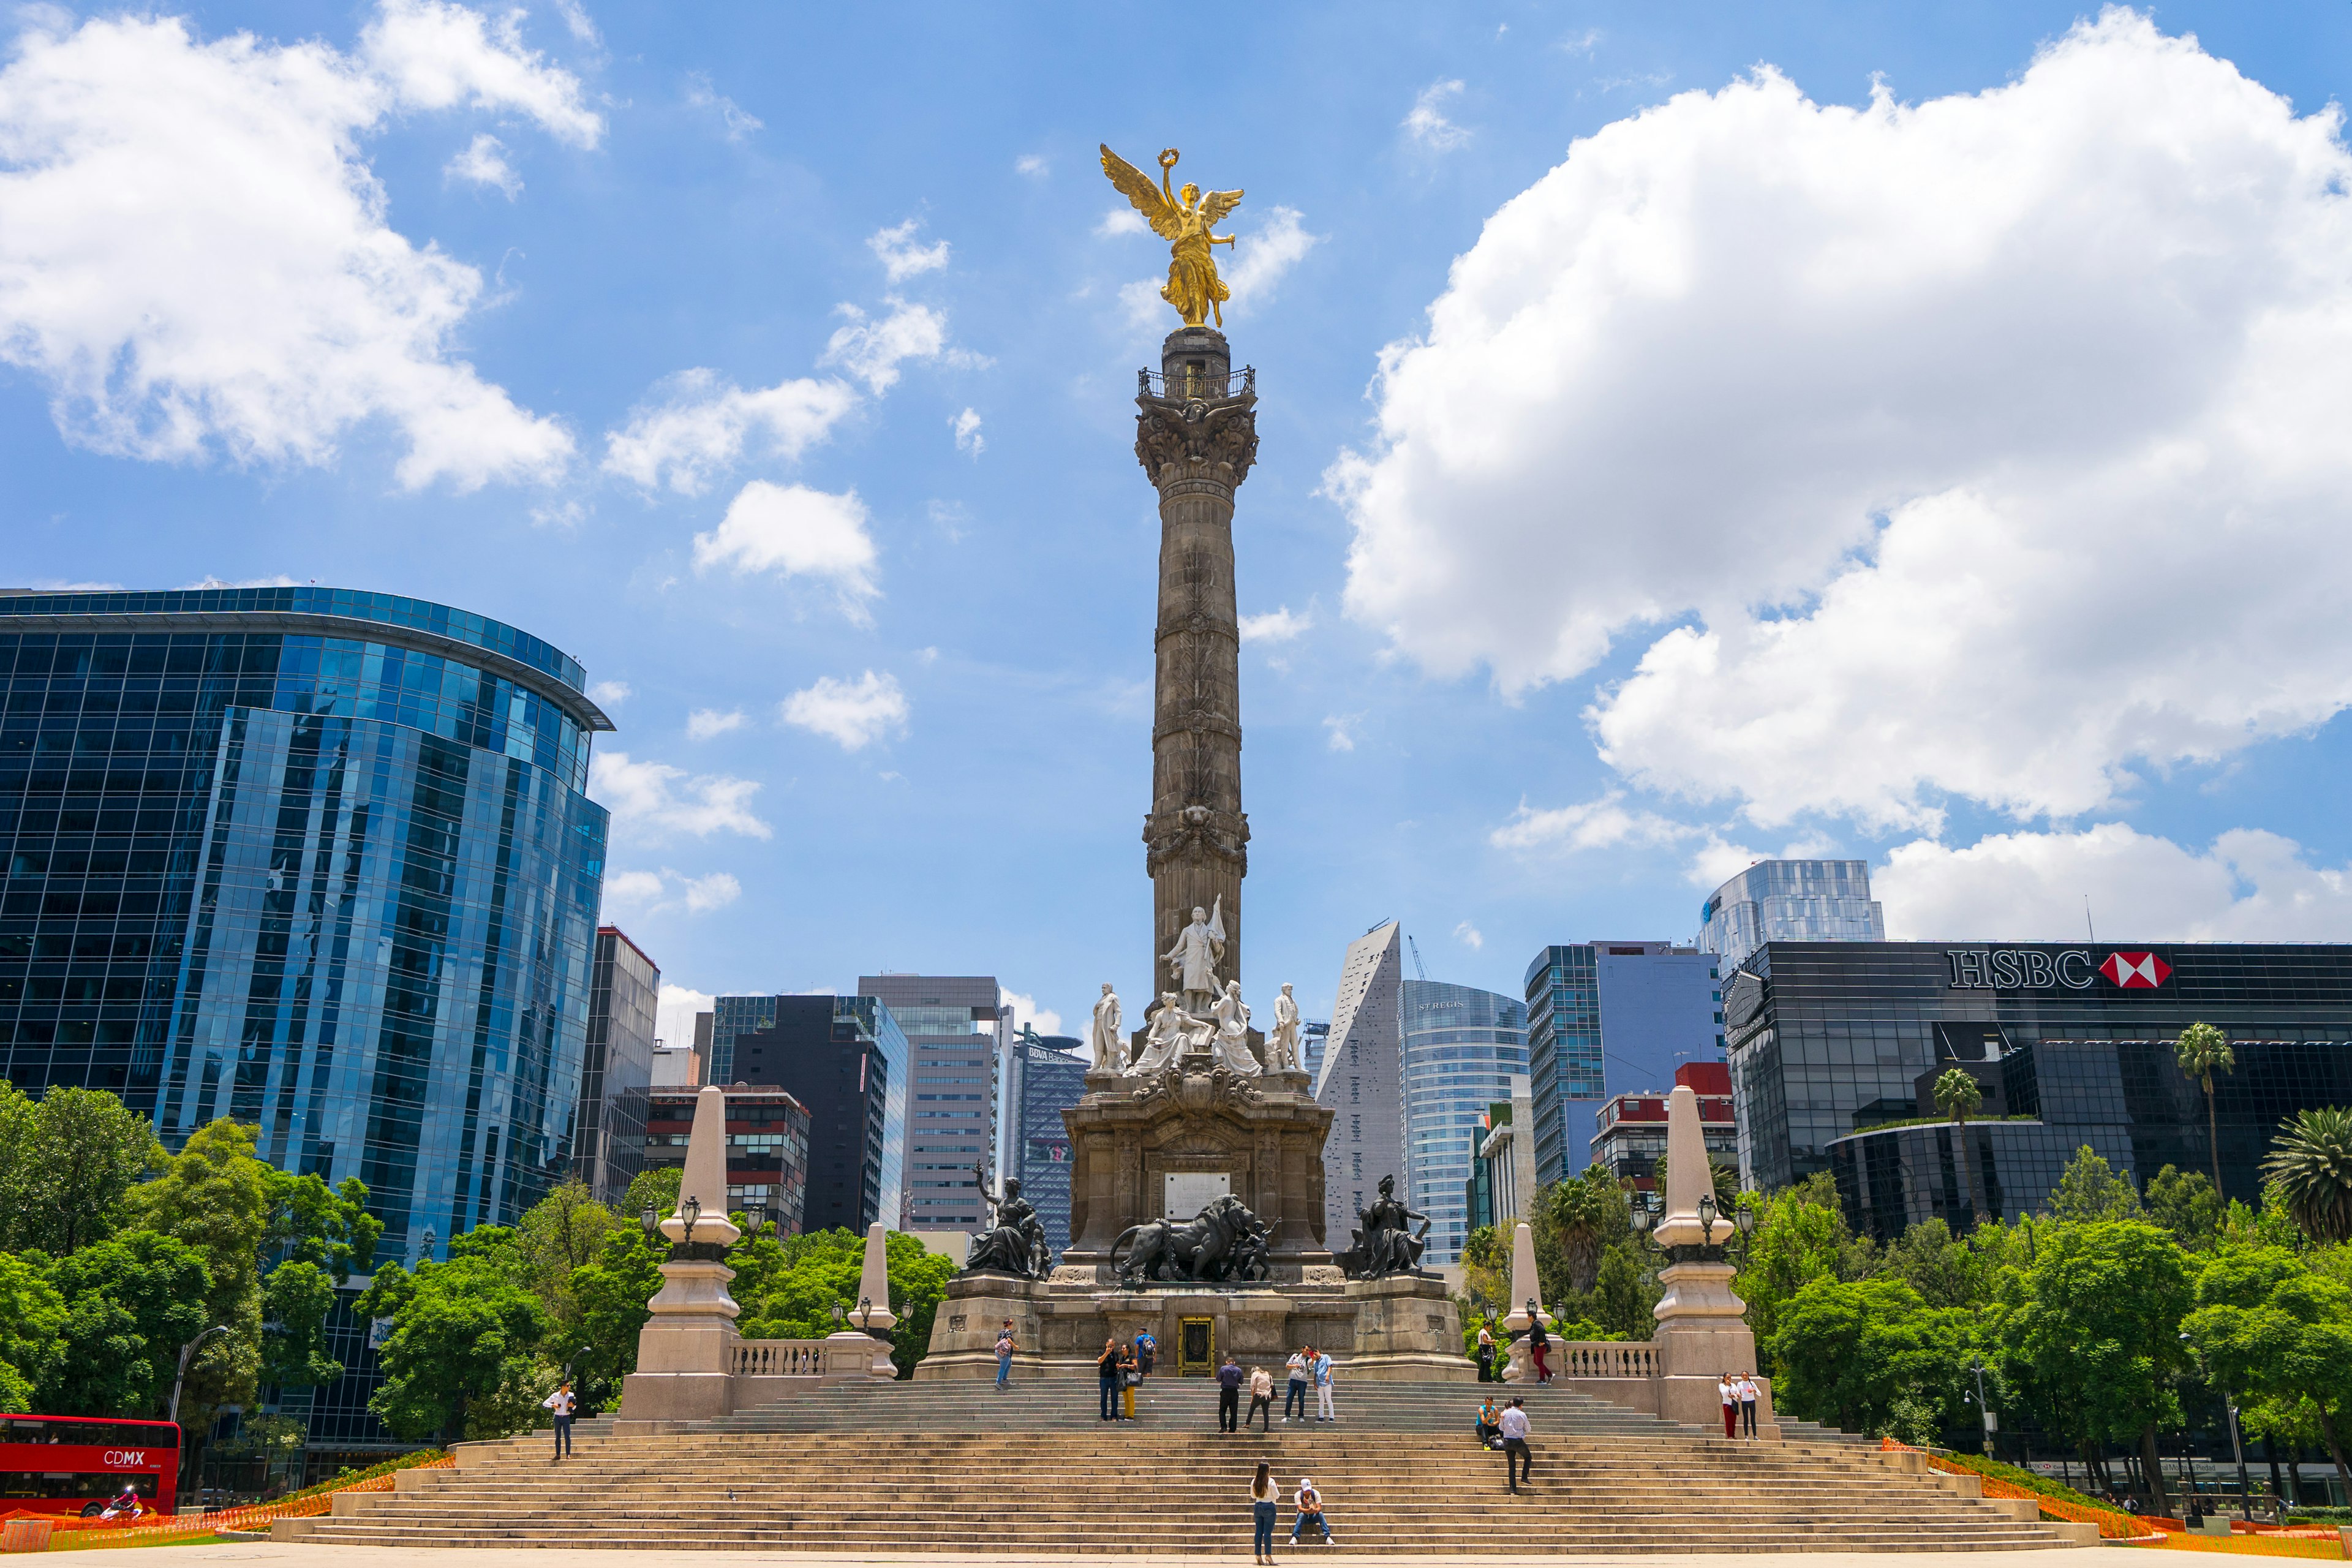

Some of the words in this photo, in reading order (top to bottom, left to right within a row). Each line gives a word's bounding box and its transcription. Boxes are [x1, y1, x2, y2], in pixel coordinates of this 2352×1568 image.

[1947, 950, 2094, 989] HSBC
[1433, 1001, 1464, 1009] REGIS
[1029, 1047, 1047, 1061] BBVA
[104, 1450, 145, 1464] CDMX
